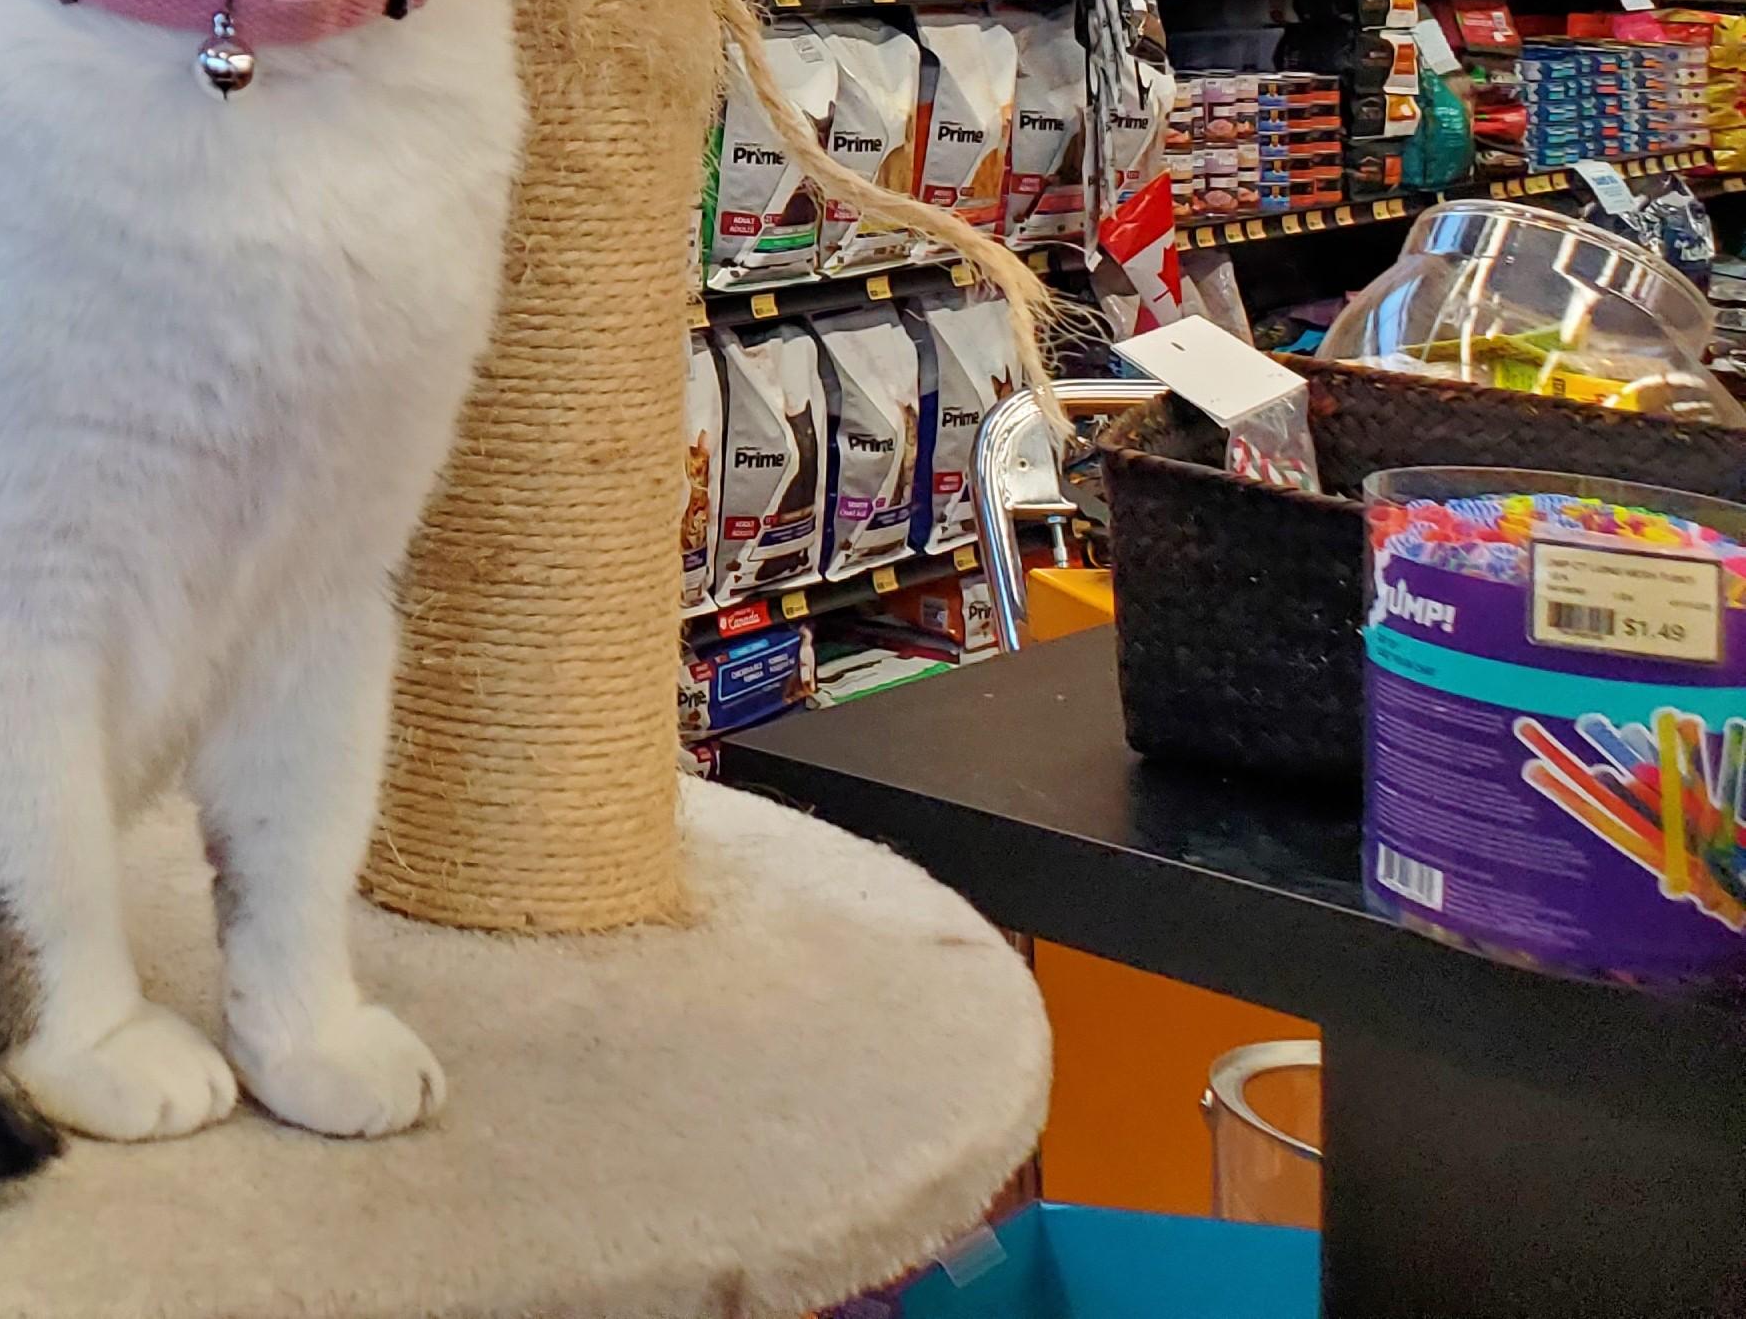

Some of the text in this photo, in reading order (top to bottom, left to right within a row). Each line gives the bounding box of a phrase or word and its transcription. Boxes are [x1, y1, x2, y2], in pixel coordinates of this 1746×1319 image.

[1019, 114, 1065, 131] Prime
[1110, 113, 1149, 130] Prime
[938, 127, 983, 144] Prime
[833, 136, 882, 153] Prime
[733, 147, 785, 165] Prime
[942, 410, 979, 428] Prime
[734, 452, 785, 469] Prime
[969, 601, 992, 619] Pri
[727, 612, 761, 630] Canada
[1622, 617, 1686, 642] $1.49
